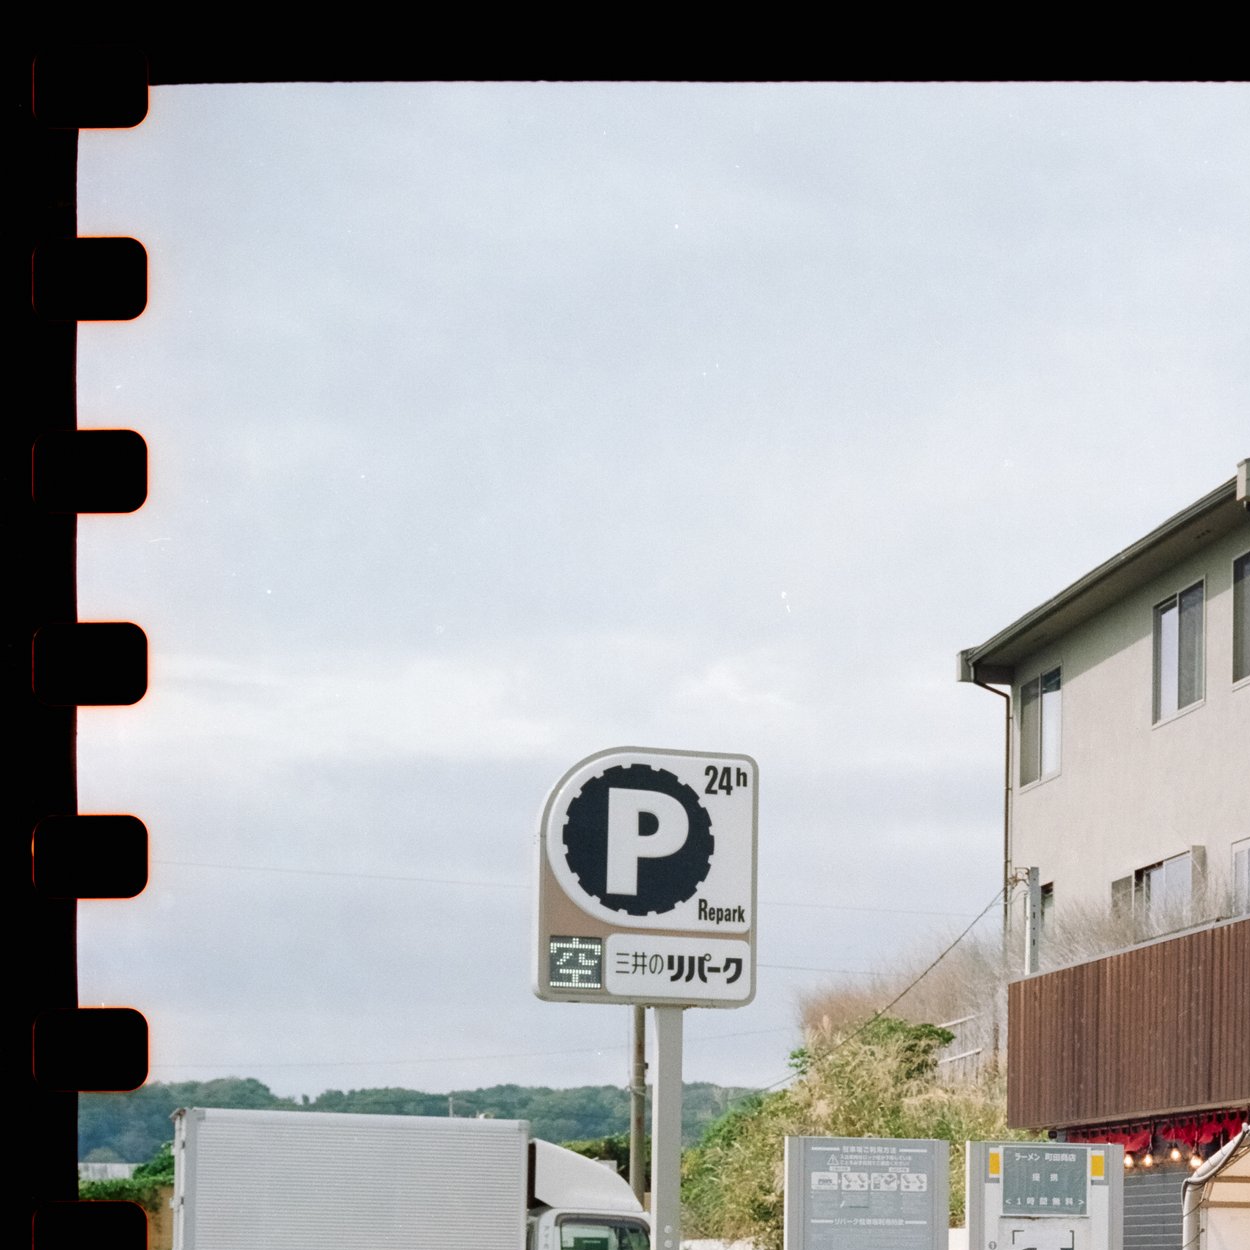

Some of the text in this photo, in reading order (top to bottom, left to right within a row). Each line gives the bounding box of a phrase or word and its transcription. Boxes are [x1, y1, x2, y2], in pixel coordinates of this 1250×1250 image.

[704, 765, 748, 796] 24h
[606, 787, 690, 896] P
[698, 898, 746, 925] Repark
[550, 938, 601, 989] 空
[615, 951, 744, 984] 三井のリパーク
[1014, 1152, 1077, 1162] ラーメン 町田商店
